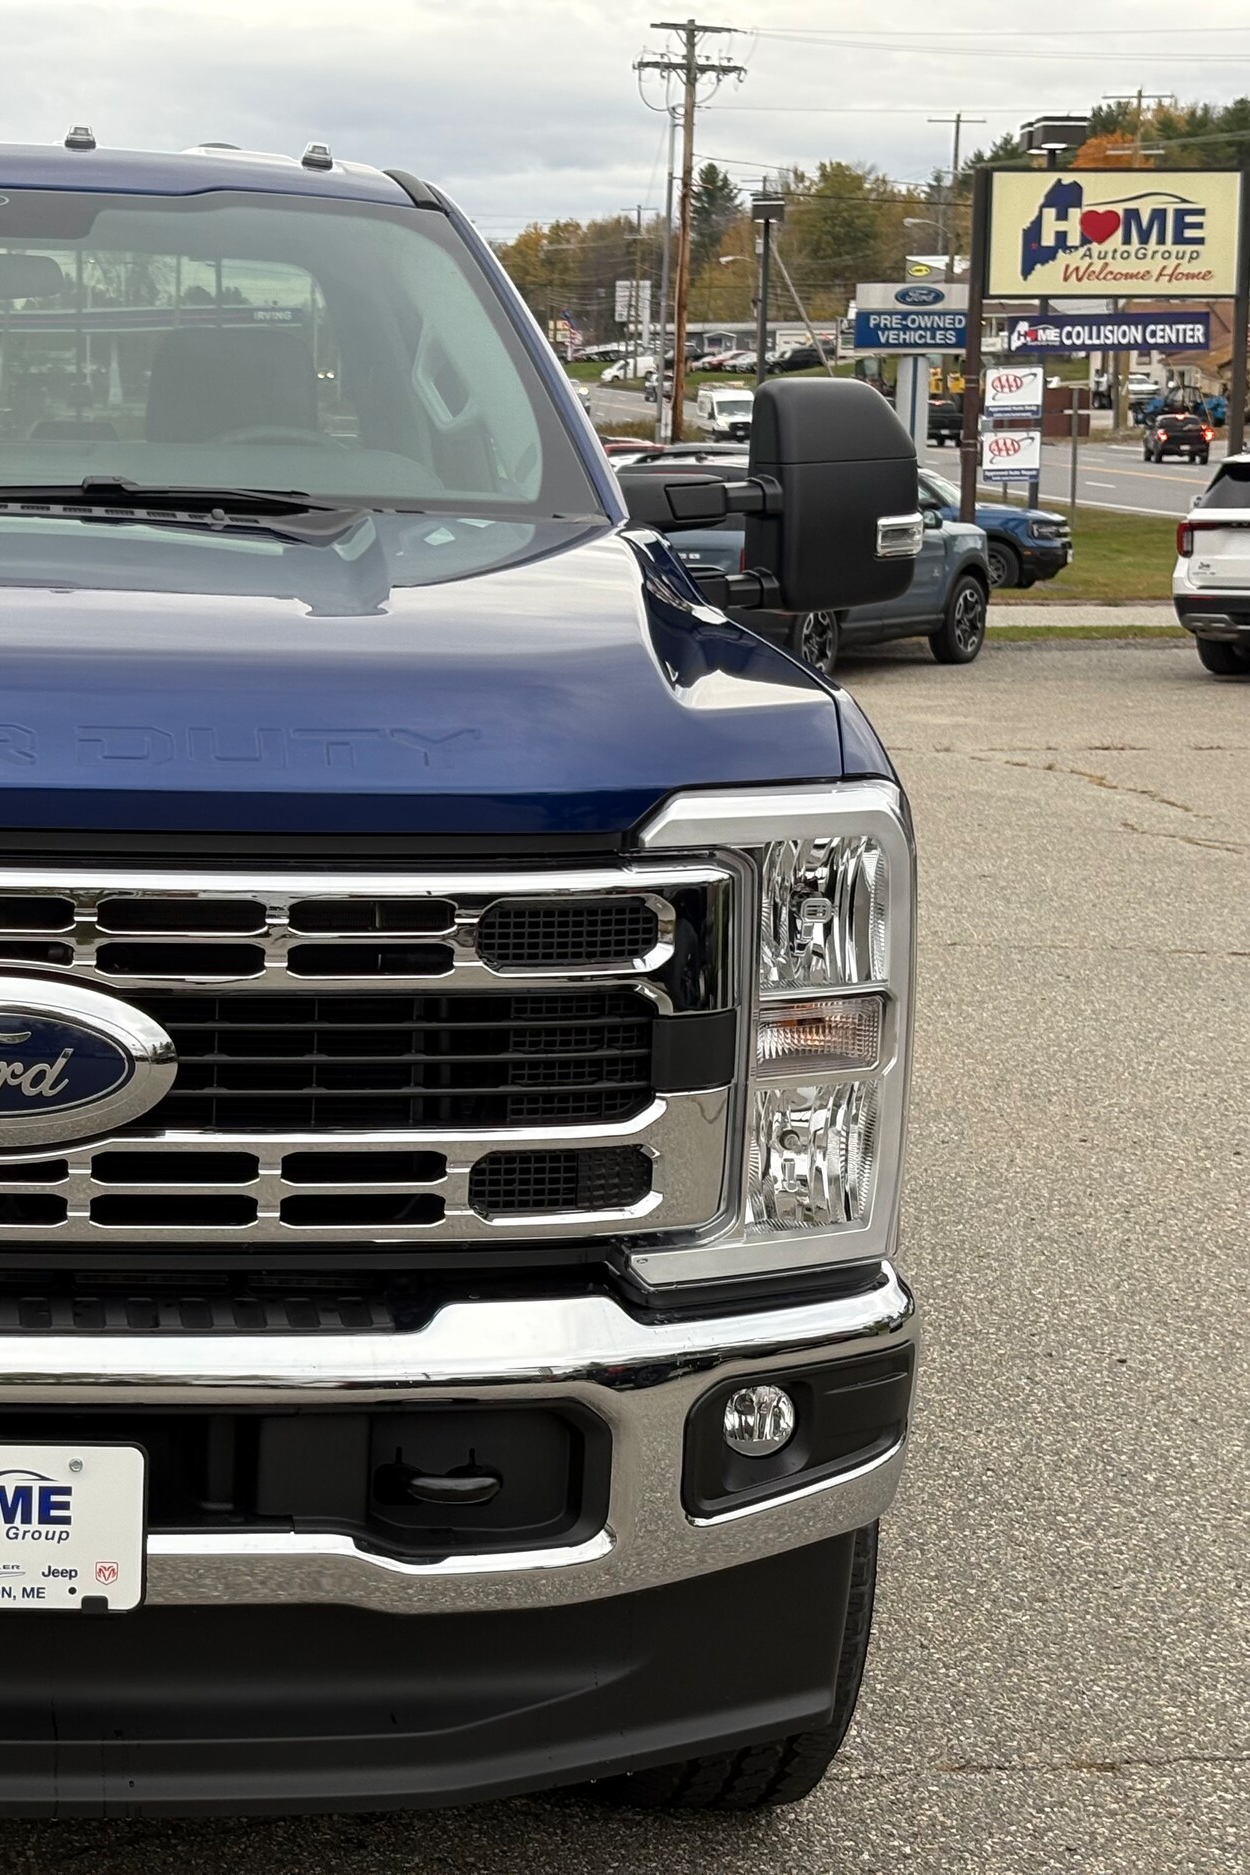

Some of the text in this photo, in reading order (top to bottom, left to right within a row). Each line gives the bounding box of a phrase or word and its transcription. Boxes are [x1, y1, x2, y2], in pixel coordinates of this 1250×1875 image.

[1061, 262, 1215, 283] Welcome Home
[869, 314, 966, 329] PRE-OWNED
[877, 330, 957, 344] VEHICLES
[1061, 324, 1143, 346] COLLISION
[1145, 323, 1206, 345] CENTER
[992, 374, 1023, 393] AAA
[989, 438, 1021, 457] AAA
[75, 724, 482, 769] DUTY
[5, 1526, 71, 1544] Group
[41, 1565, 79, 1580] Jeep
[21, 1586, 47, 1600] ME
